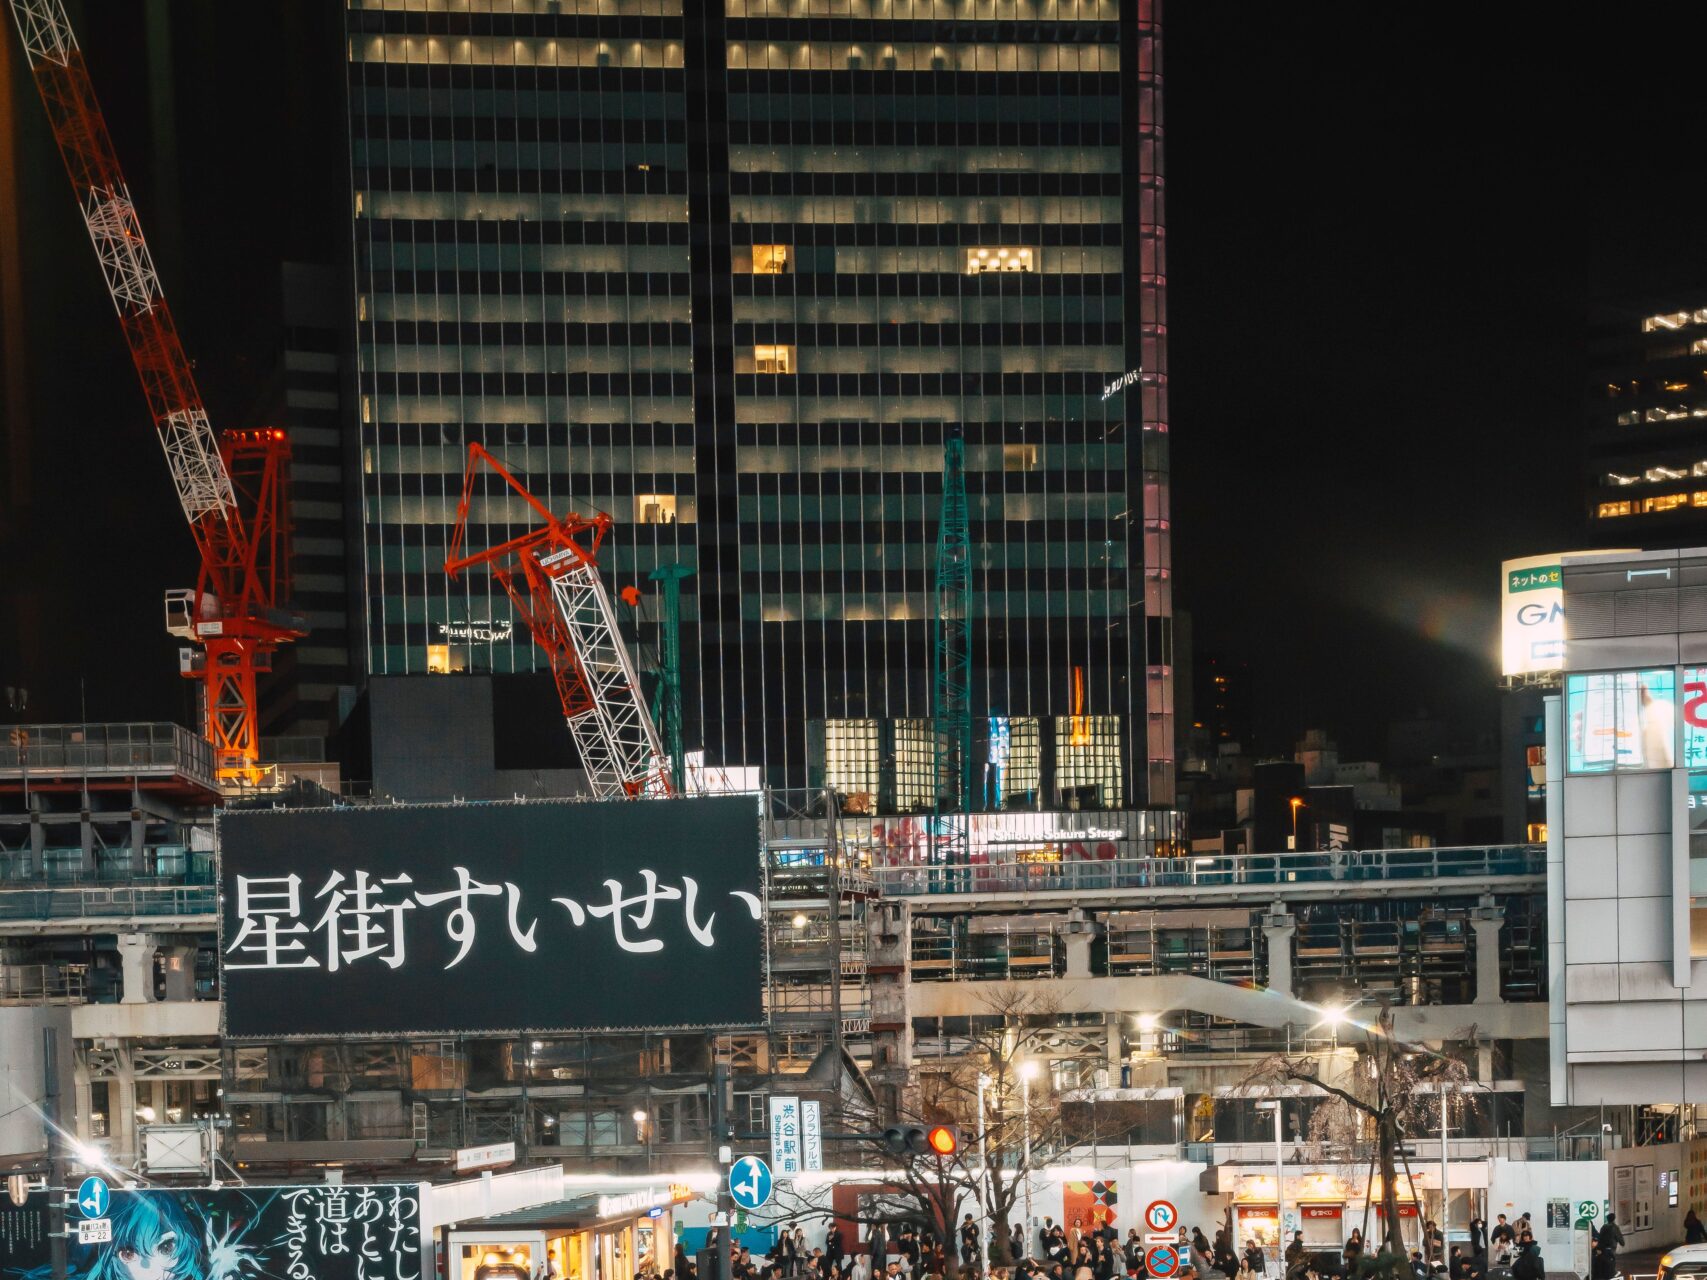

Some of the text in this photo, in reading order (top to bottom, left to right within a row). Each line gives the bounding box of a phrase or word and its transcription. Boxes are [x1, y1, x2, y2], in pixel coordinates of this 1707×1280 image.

[994, 827, 1122, 842] Shibuya Sakura Stage
[223, 867, 761, 972] 星街すいせい
[783, 1104, 797, 1172] 渋谷駅前
[806, 1104, 818, 1169] スクランブル式
[315, 1187, 351, 1255] 道は
[1581, 1203, 1598, 1217] 29
